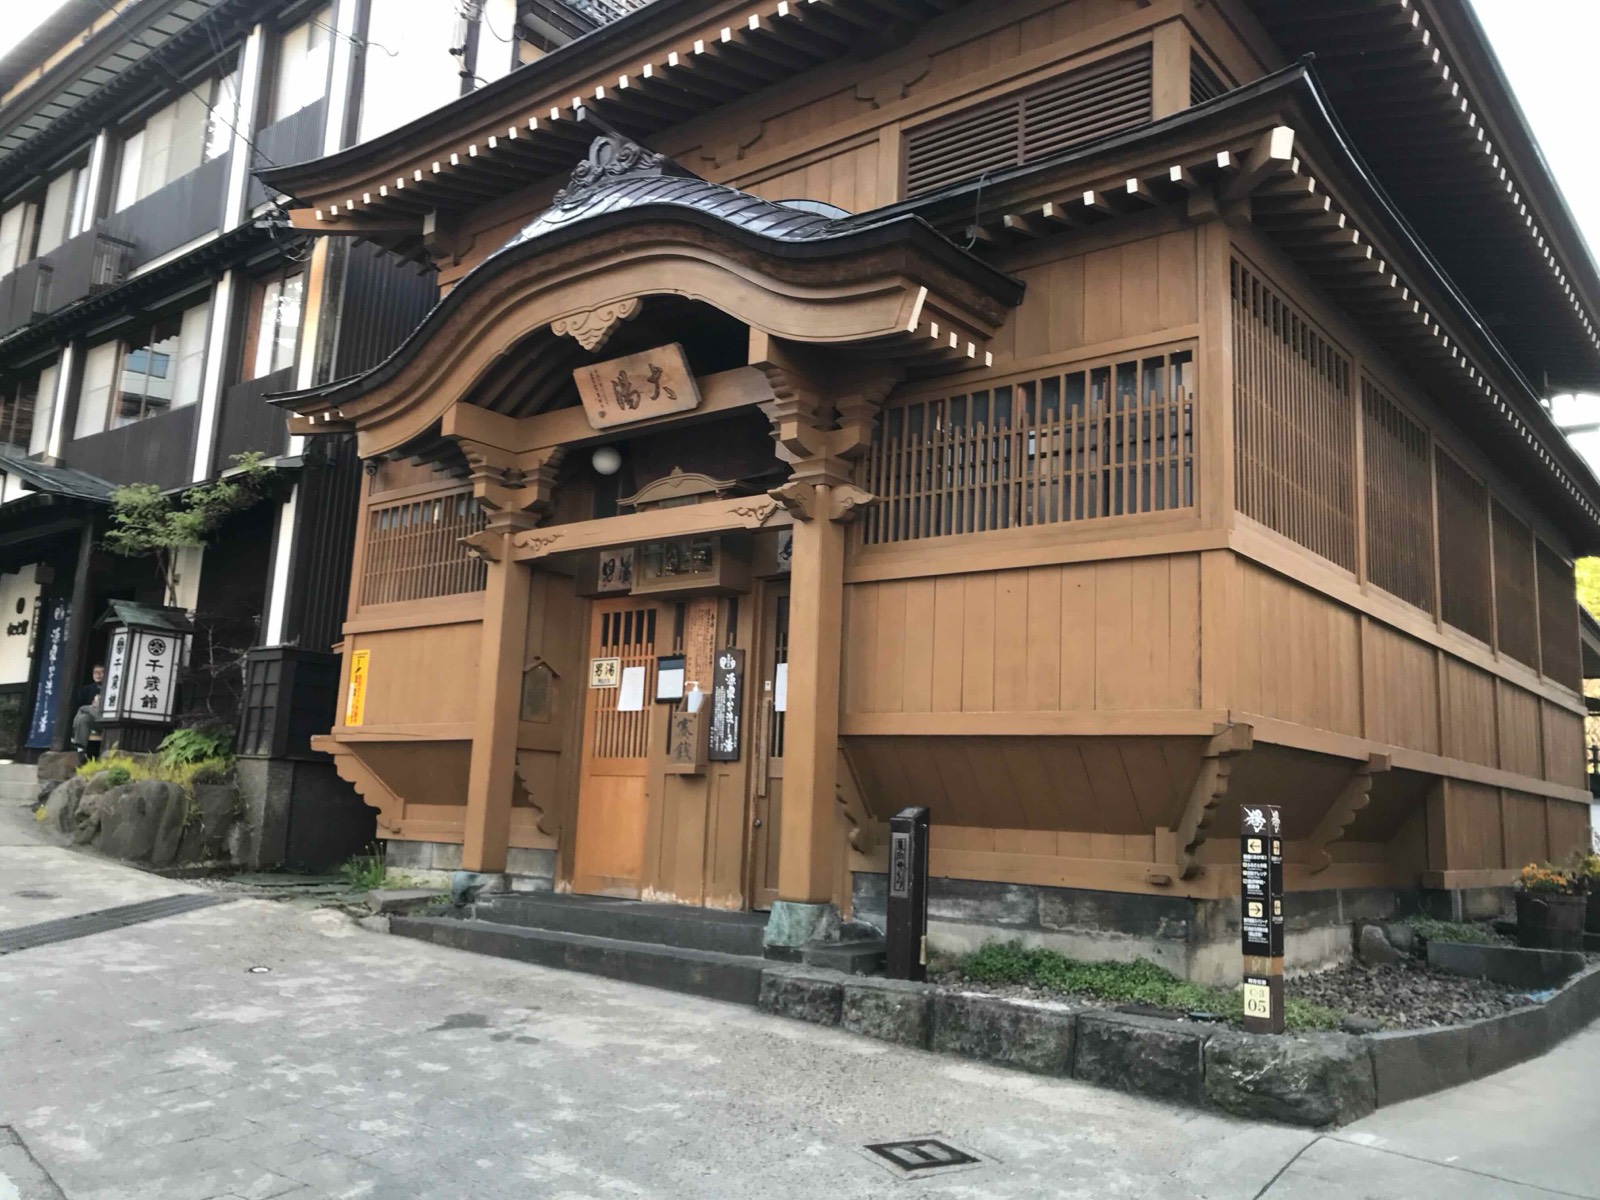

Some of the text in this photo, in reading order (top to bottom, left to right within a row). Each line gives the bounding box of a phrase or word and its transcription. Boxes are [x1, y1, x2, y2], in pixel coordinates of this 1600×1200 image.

[595, 662, 615, 677] 男湯
[140, 659, 164, 709] 千歳館
[1248, 999, 1267, 1013] 05
